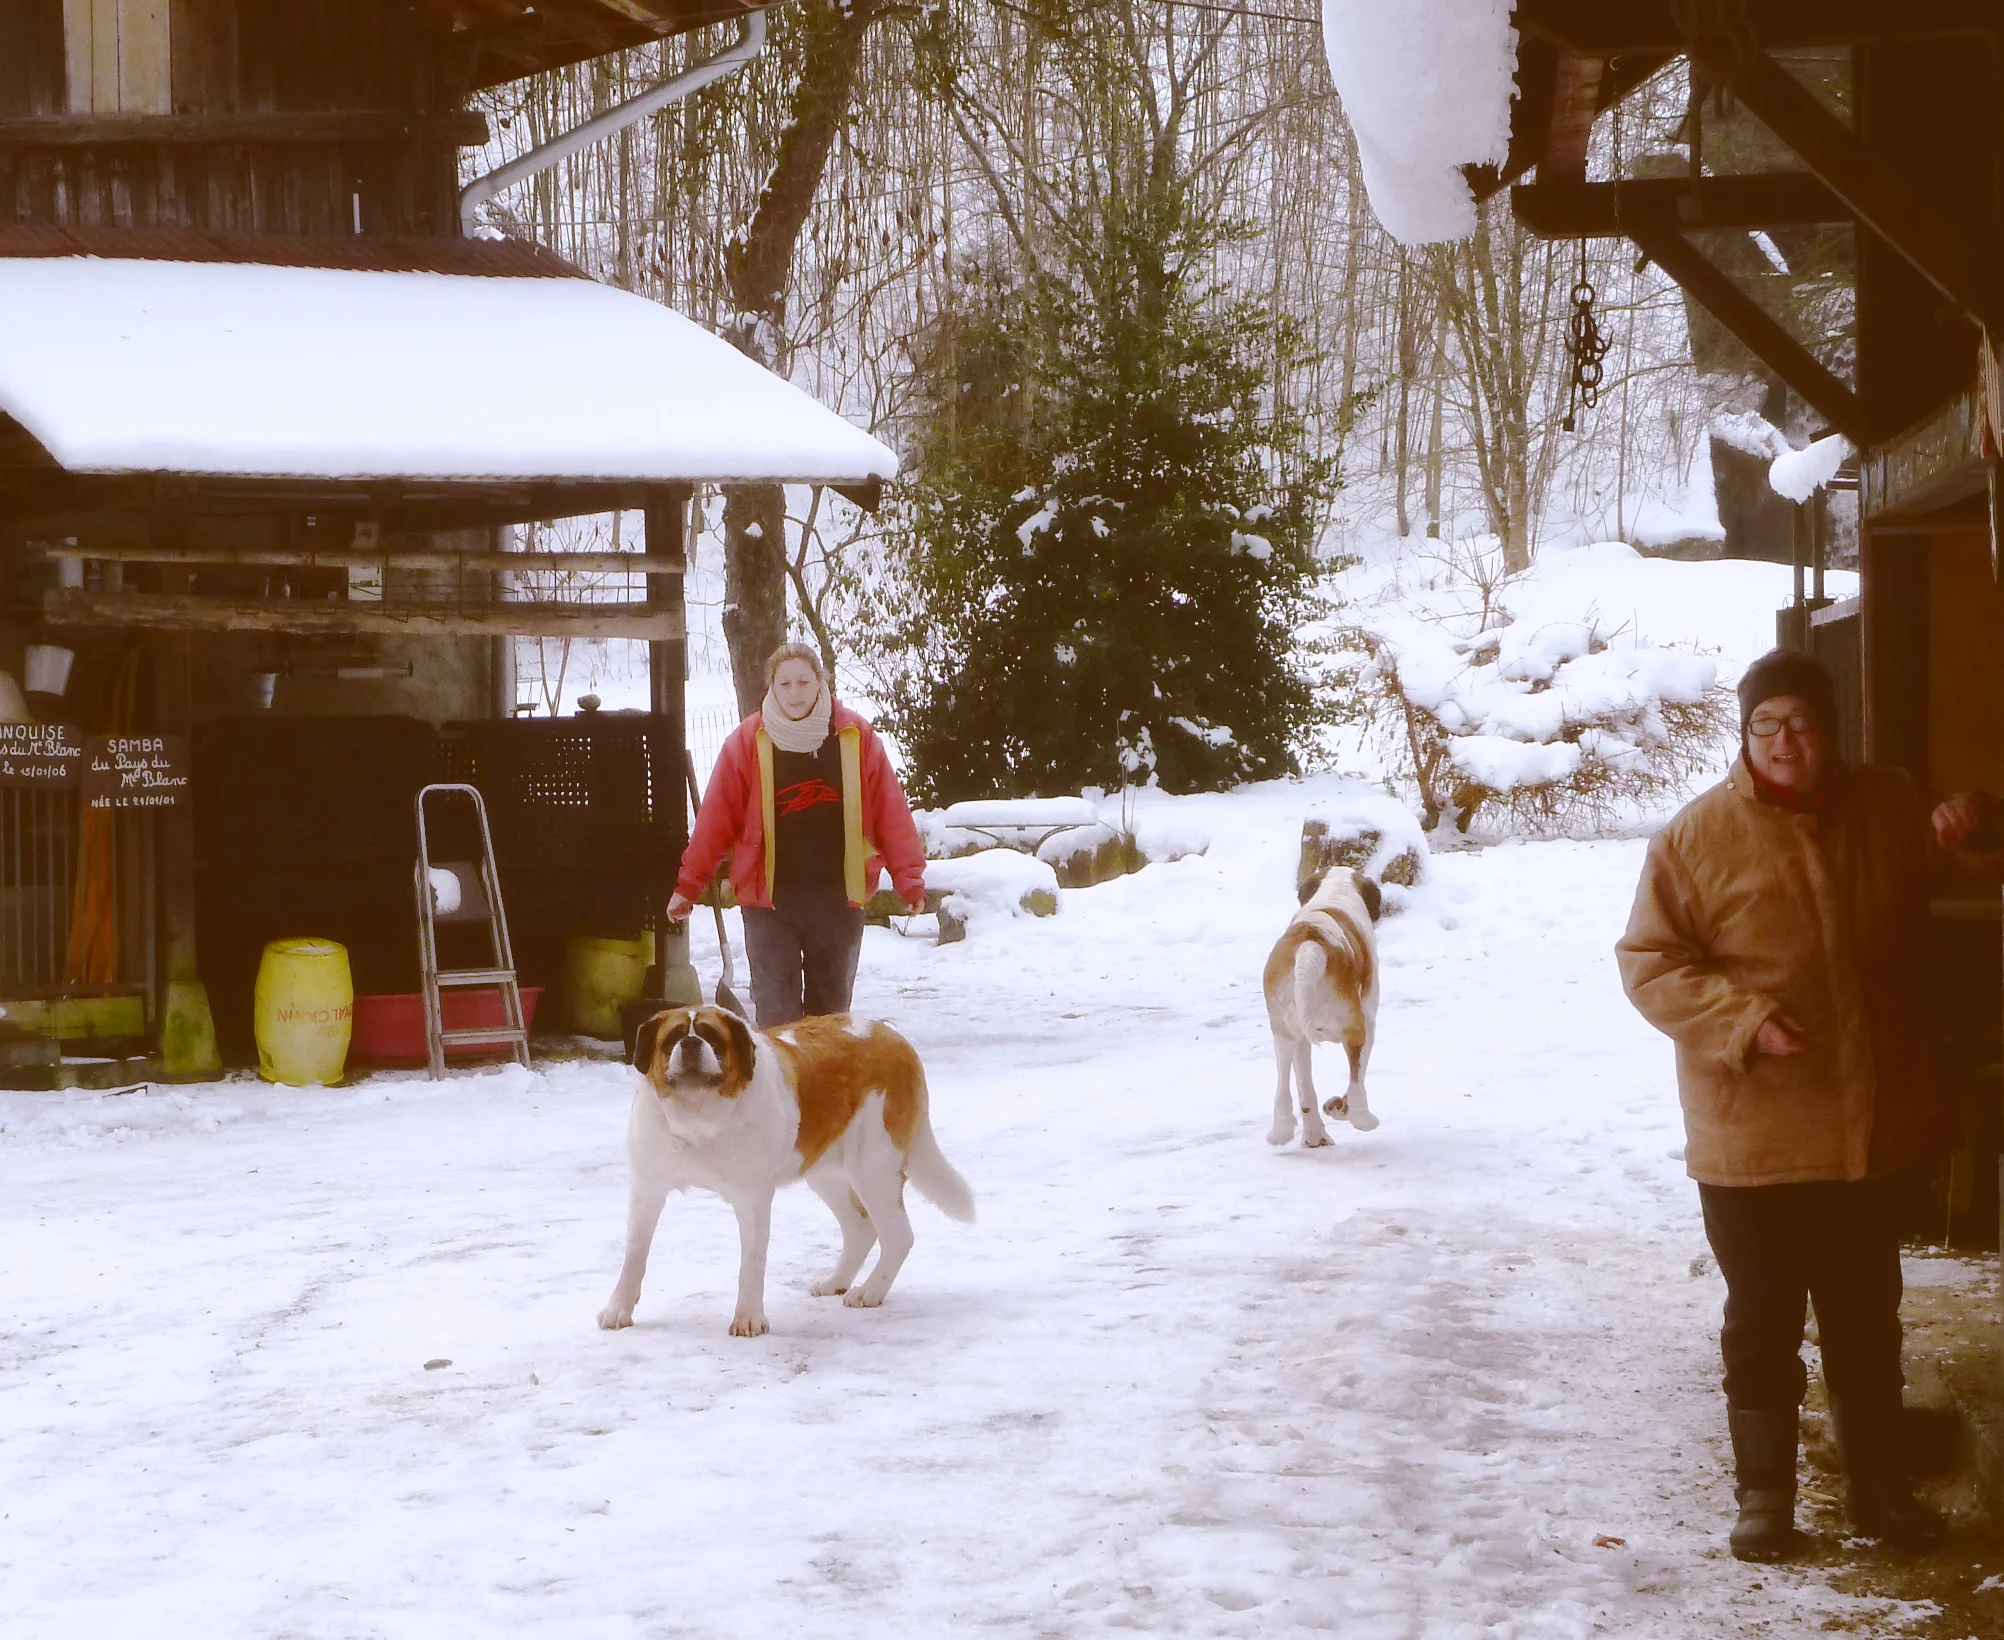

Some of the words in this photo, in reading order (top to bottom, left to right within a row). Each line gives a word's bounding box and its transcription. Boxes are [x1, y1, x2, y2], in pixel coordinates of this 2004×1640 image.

[9, 741, 27, 756] du
[43, 740, 81, 757] Blanc
[106, 737, 164, 753] SAMBA
[91, 755, 110, 771] du
[114, 753, 148, 778] Pays
[151, 754, 171, 768] du
[141, 770, 188, 787] Blanc
[91, 794, 111, 808] NÉE
[115, 797, 128, 807] LE
